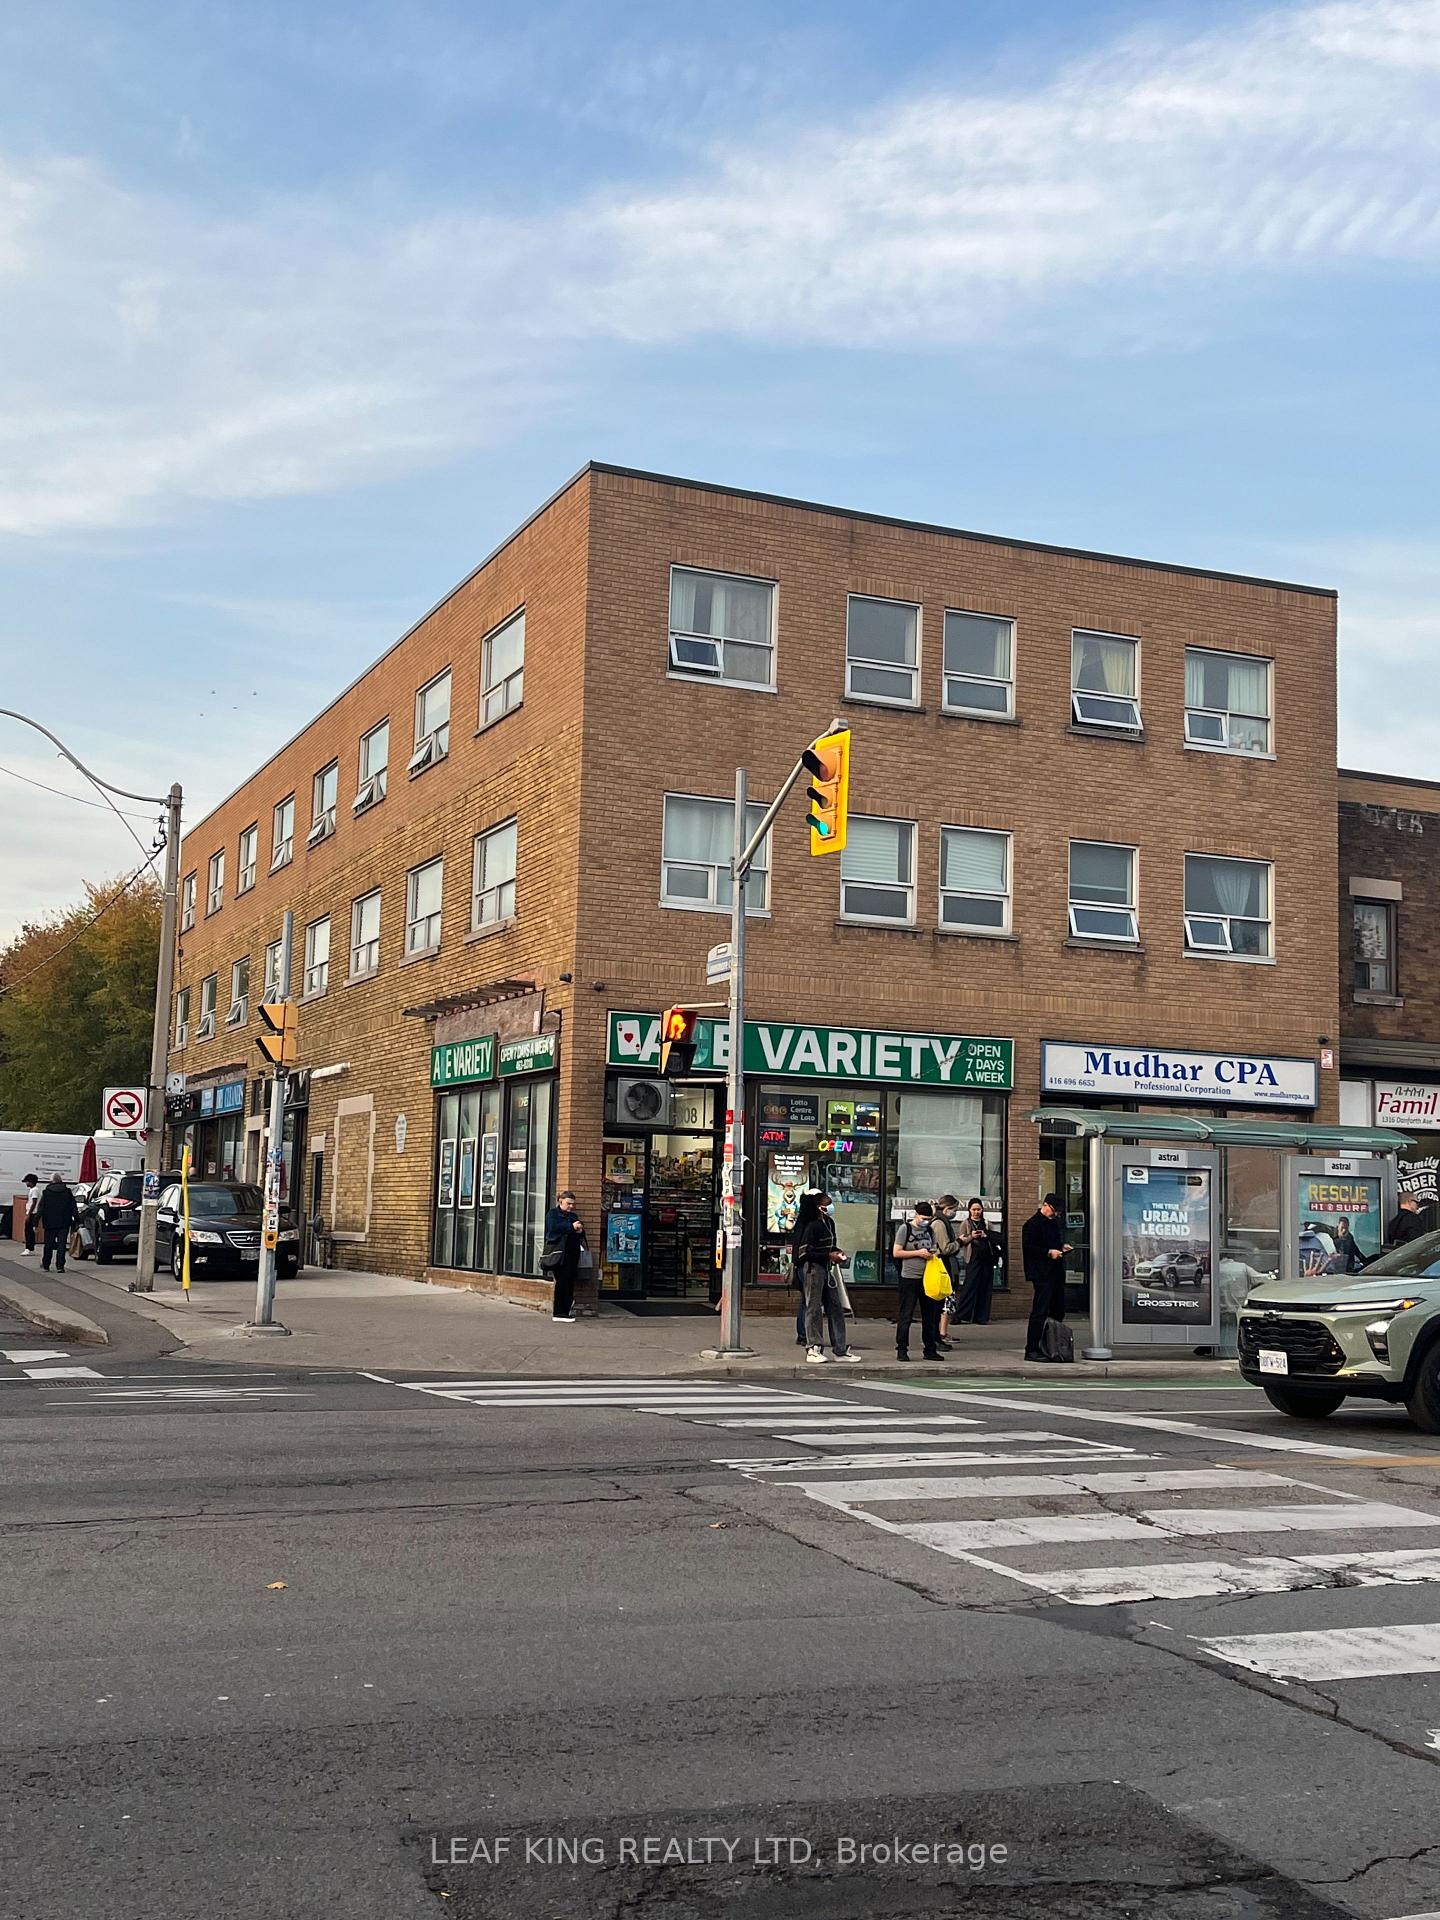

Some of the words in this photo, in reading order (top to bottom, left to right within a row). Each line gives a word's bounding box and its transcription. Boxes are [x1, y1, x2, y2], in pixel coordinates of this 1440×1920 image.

[500, 1047, 514, 1063] OPEN
[757, 1027, 962, 1081] VARIETY
[968, 1043, 1001, 1058] OPEN
[453, 1041, 492, 1077] VARIETY
[965, 1058, 973, 1069] 7
[975, 1059, 1005, 1071] DAYS
[1083, 1051, 1203, 1081] Mudhar
[1214, 1060, 1279, 1086] CPA
[965, 1071, 974, 1082] A
[975, 1071, 1005, 1083] WEEK
[1049, 1077, 1062, 1085] 416
[1063, 1078, 1077, 1086] 696
[1134, 1080, 1182, 1092] Professional
[1184, 1083, 1231, 1096] Corporation
[790, 1099, 808, 1107] Lotto
[1378, 1092, 1440, 1115] Famil
[762, 1131, 785, 1141] ATM
[818, 1139, 853, 1152] OPEN
[1158, 1153, 1180, 1162] astral
[1398, 1156, 1440, 1169] Family
[1331, 1162, 1352, 1171] astral
[1308, 1184, 1369, 1202] RESCUE
[1310, 1203, 1325, 1211] HI
[1335, 1204, 1368, 1213] SURF
[1142, 1209, 1188, 1223] URBAN
[1140, 1223, 1190, 1236] LEGEND
[1137, 1300, 1199, 1308] CROSSTREK
